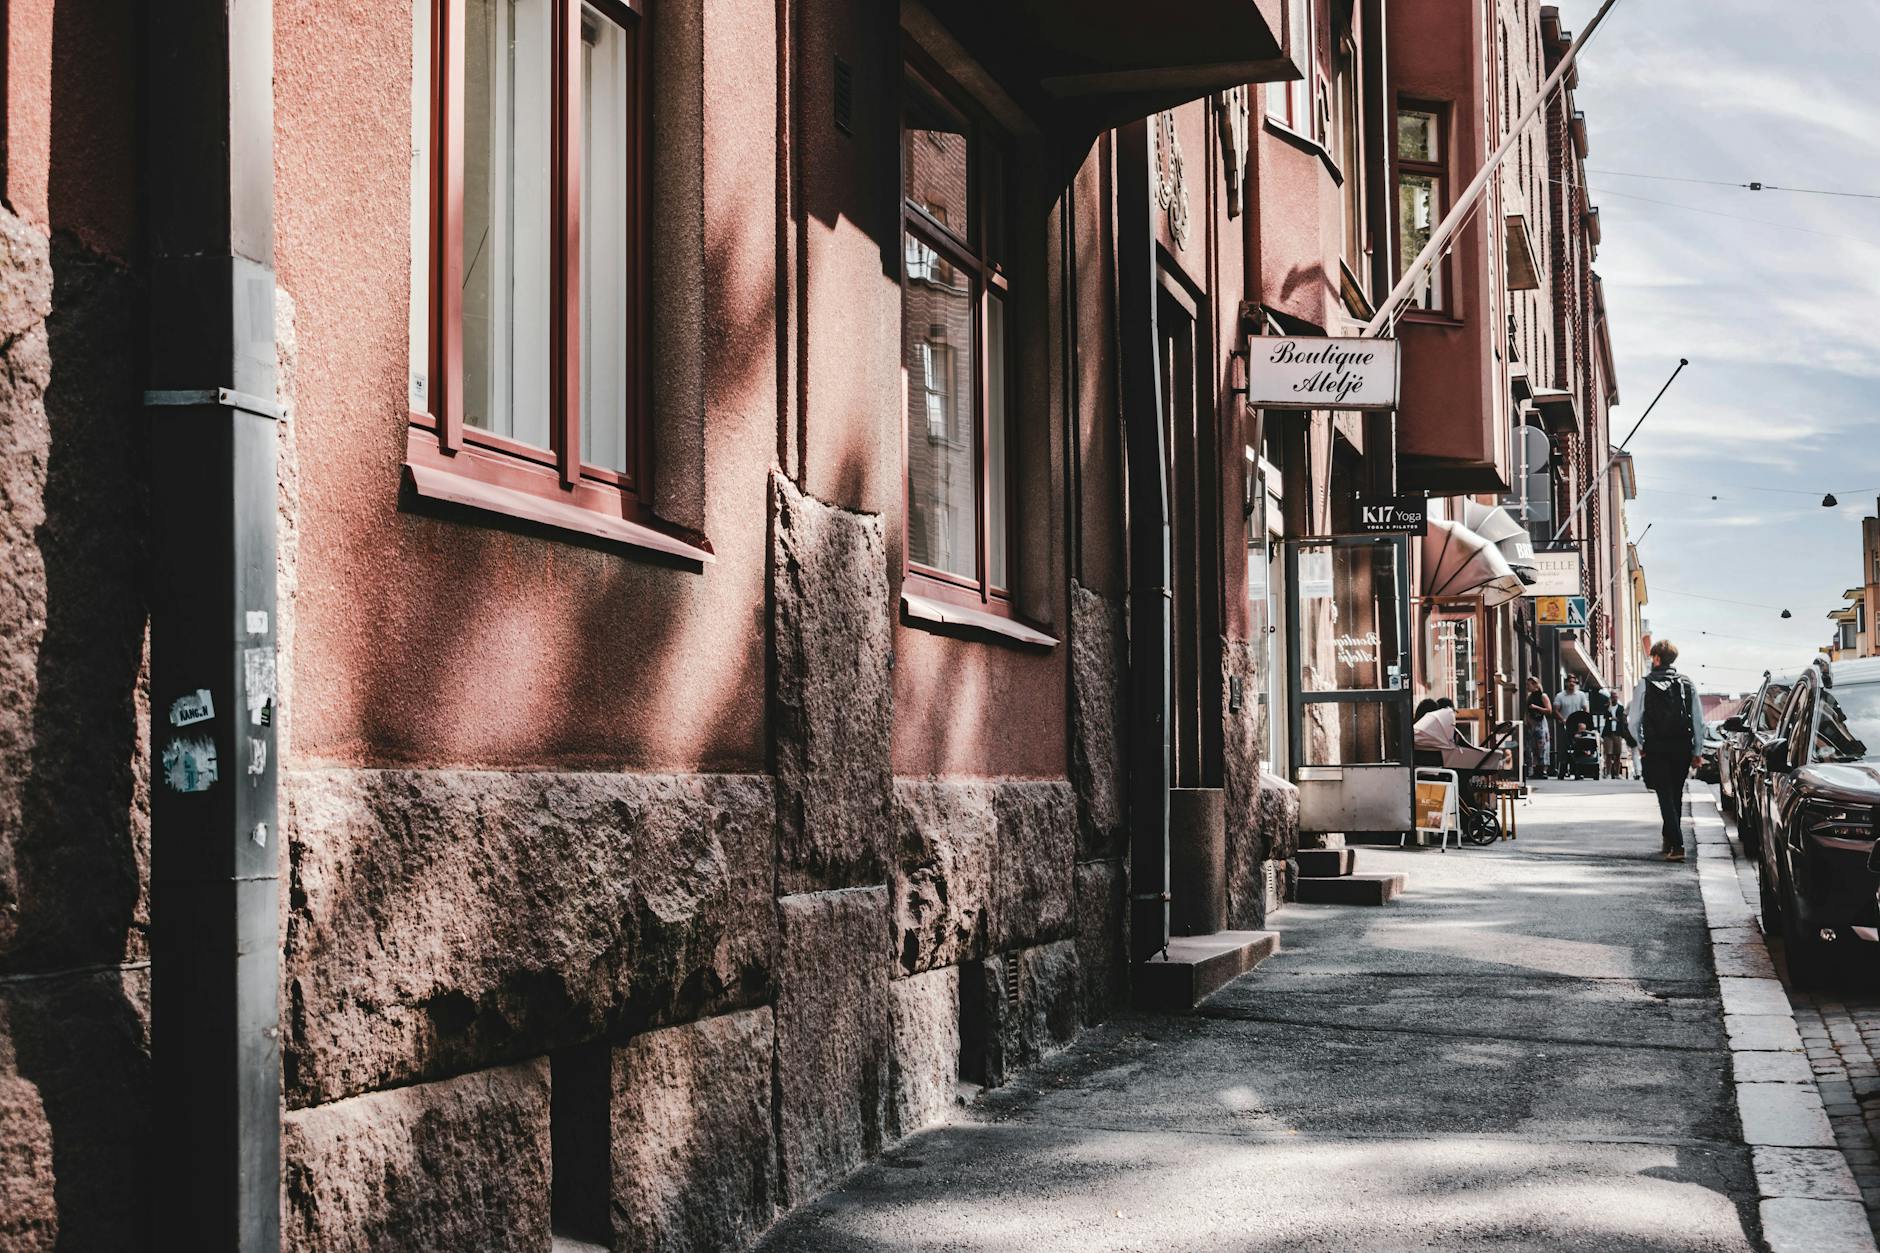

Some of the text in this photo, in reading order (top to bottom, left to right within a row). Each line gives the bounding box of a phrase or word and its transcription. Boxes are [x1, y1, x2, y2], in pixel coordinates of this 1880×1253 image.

[1270, 341, 1374, 373] Boutique
[1293, 370, 1363, 402] Ateljé
[1362, 506, 1422, 523] K17 Yoga
